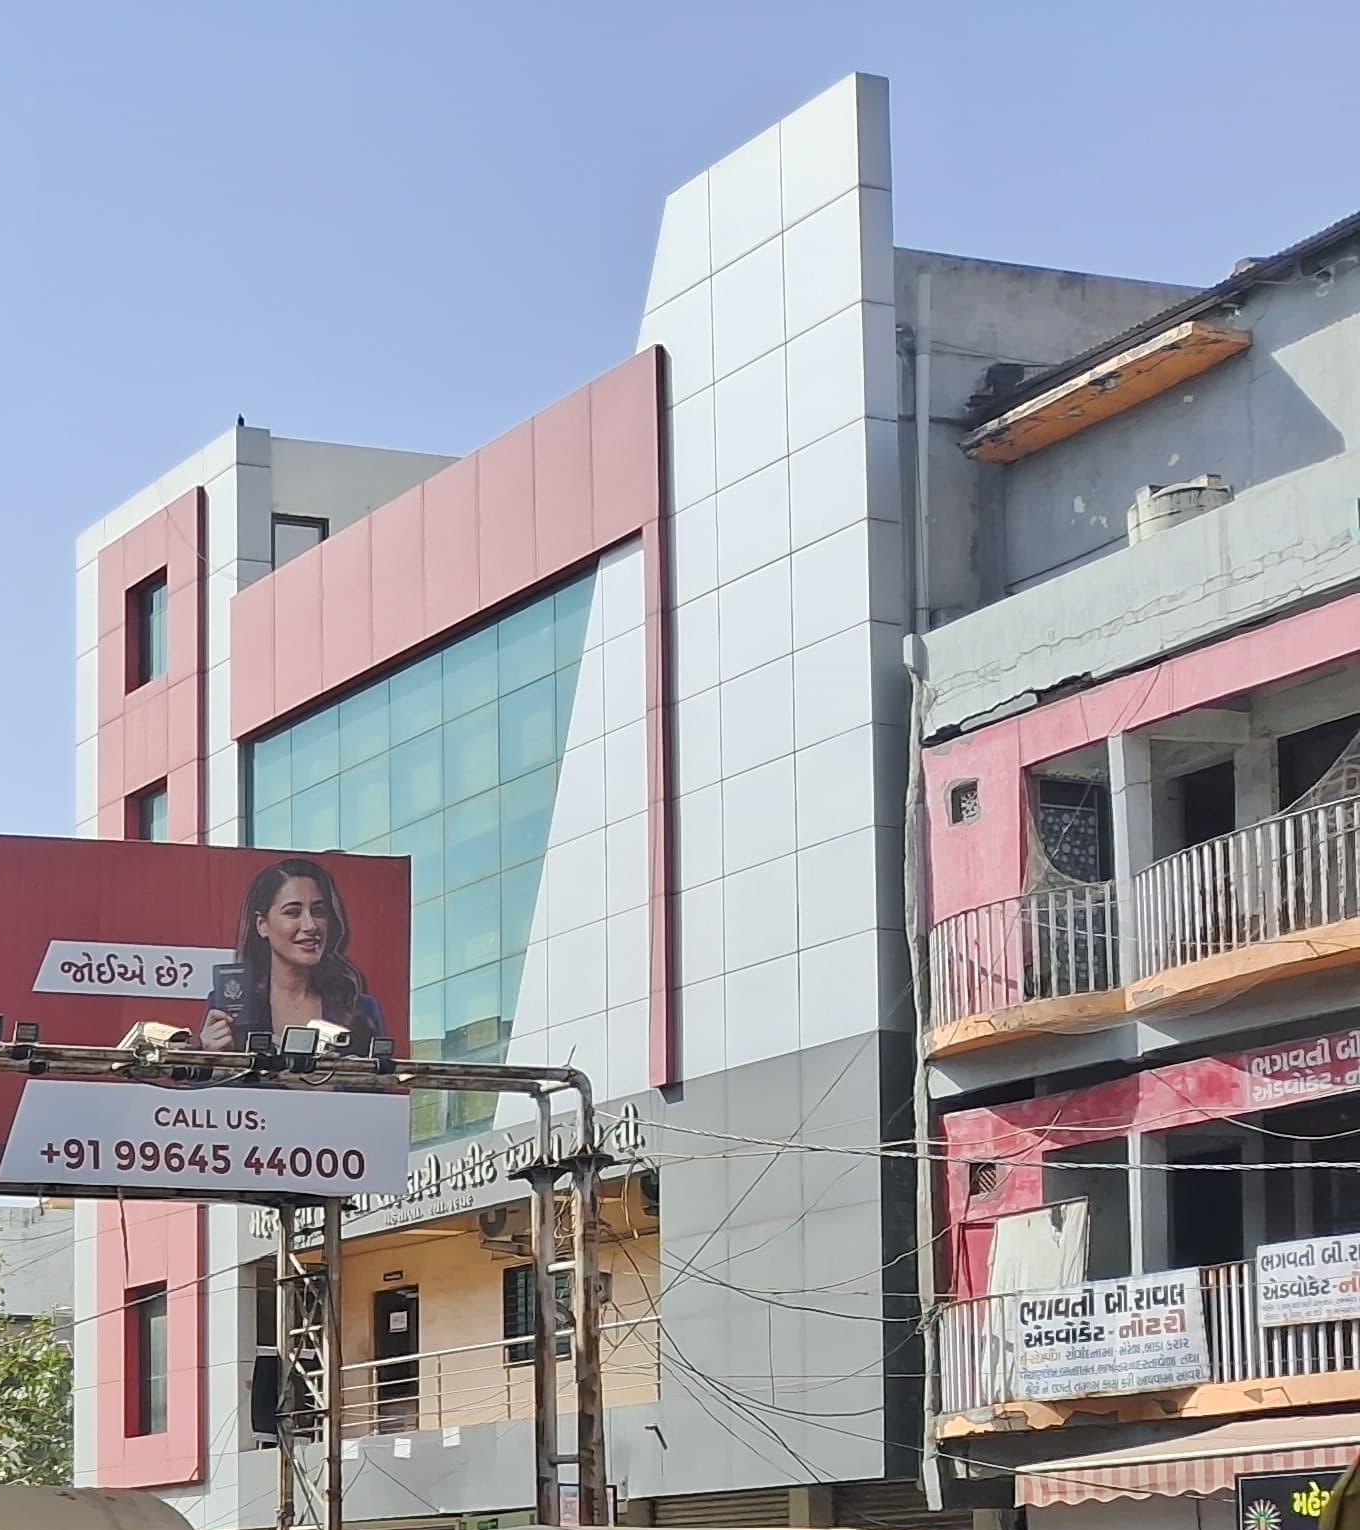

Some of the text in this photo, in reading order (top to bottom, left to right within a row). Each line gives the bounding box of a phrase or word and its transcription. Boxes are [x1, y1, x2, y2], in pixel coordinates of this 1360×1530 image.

[58, 952, 194, 989] જોઈએ છે?
[1250, 1038, 1331, 1077] ભગવતી
[1252, 1070, 1333, 1102] એડવોકેટ
[153, 1107, 267, 1133] CALL US:
[38, 1138, 367, 1182] +91 99645 44000
[1260, 1243, 1316, 1273] ભગવતી
[1019, 1282, 1186, 1326] ભગવતી બી.રાવલ
[1262, 1276, 1332, 1301] એડવોકેટ
[1023, 1308, 1188, 1350] એડવોકેટ નોટરી
